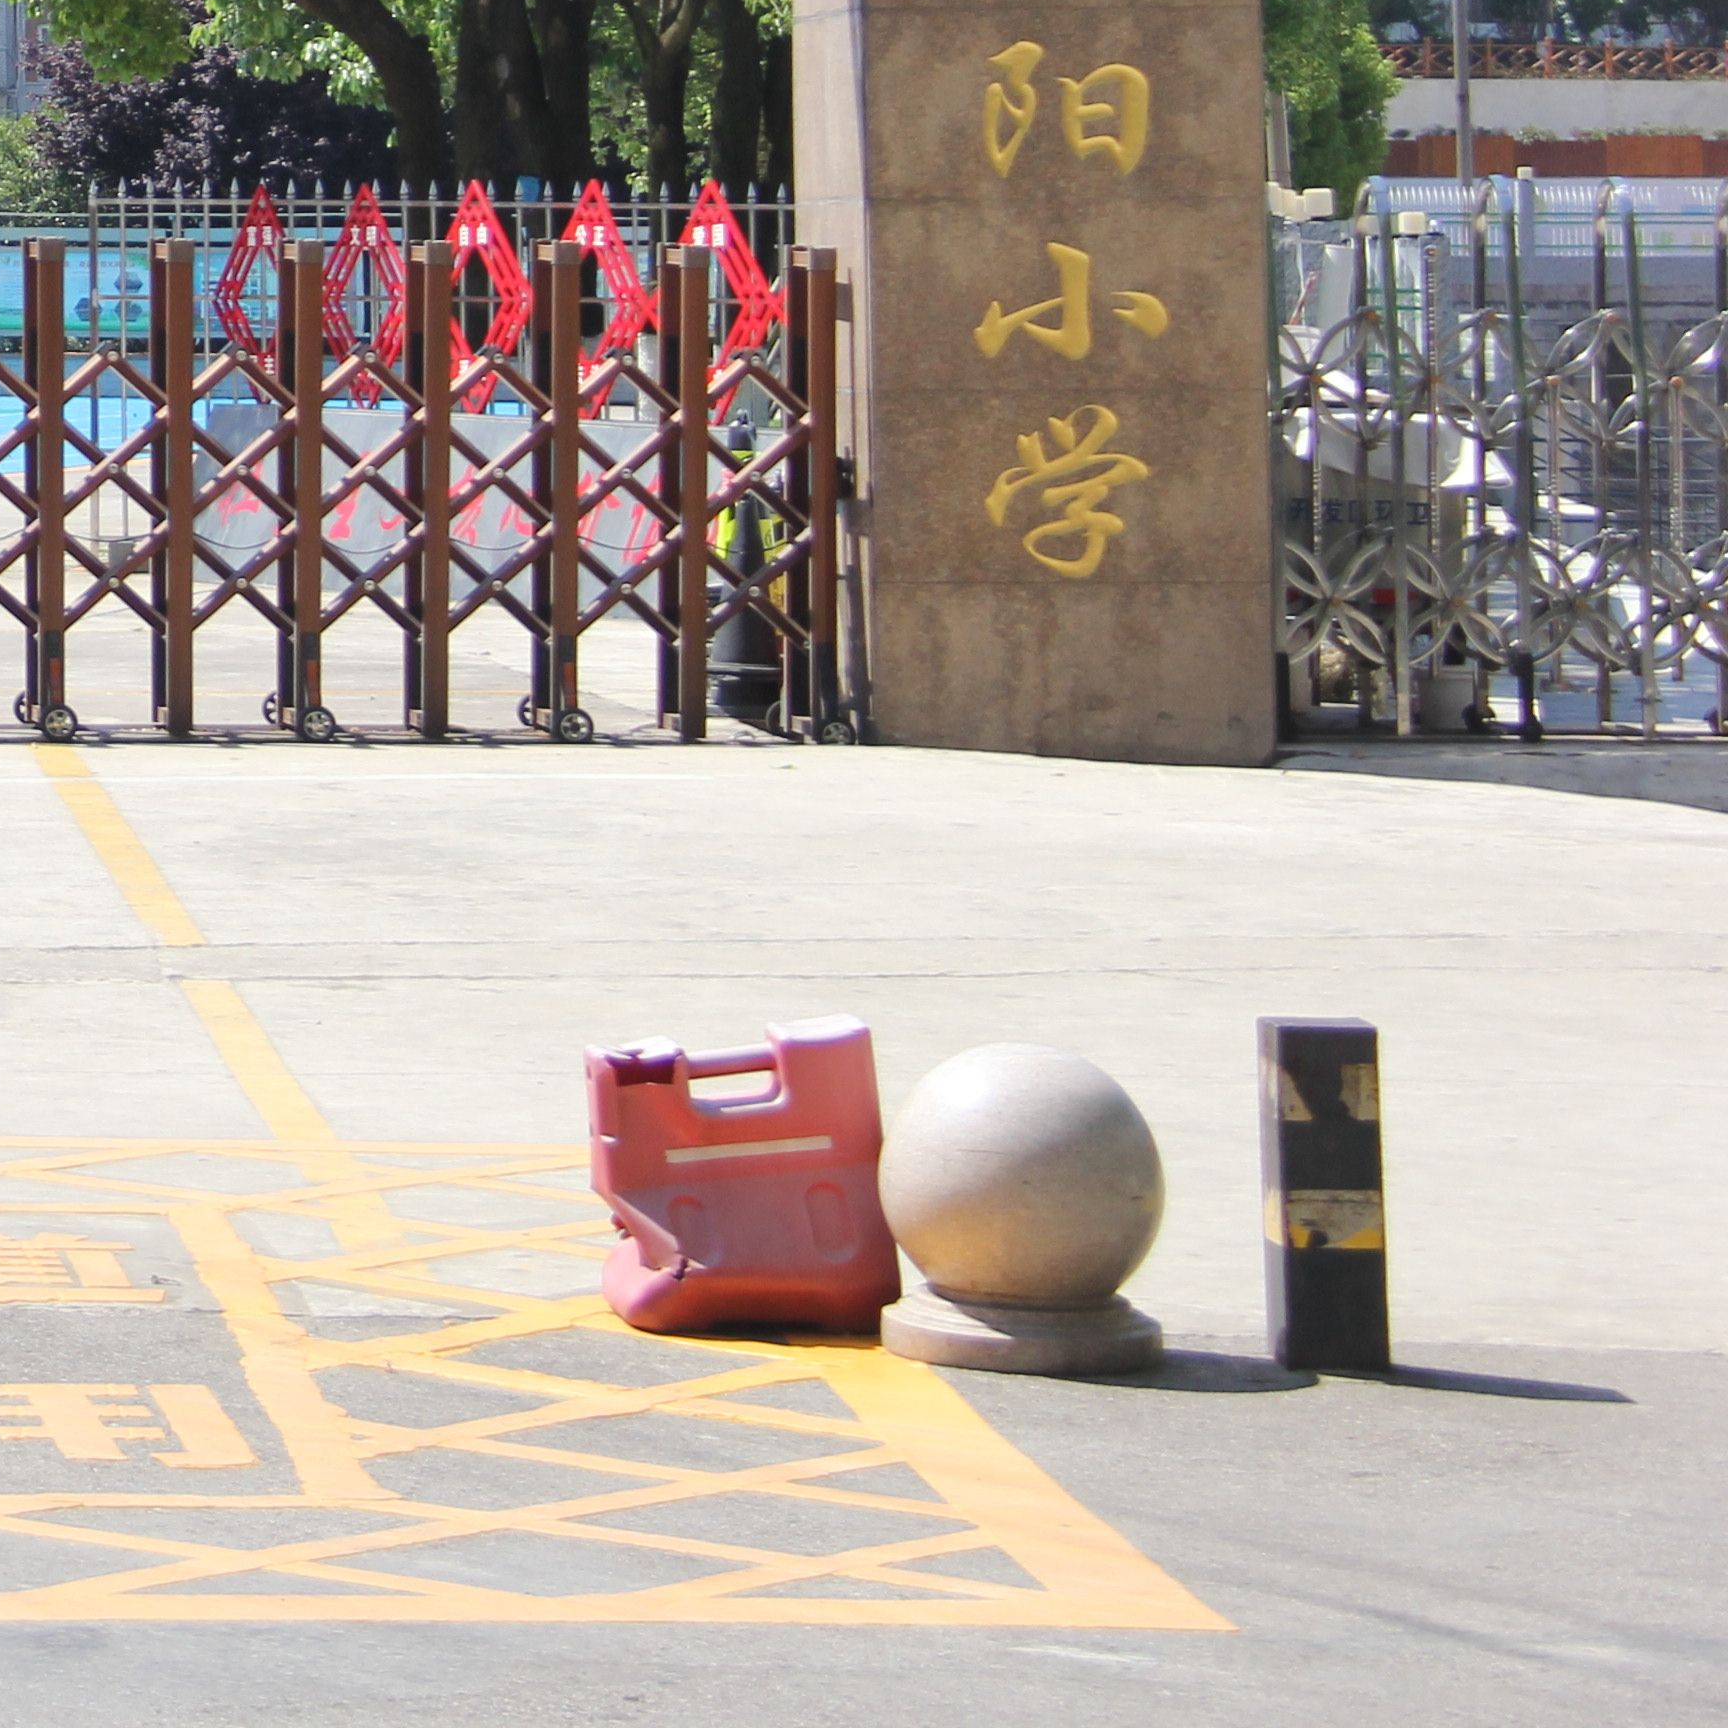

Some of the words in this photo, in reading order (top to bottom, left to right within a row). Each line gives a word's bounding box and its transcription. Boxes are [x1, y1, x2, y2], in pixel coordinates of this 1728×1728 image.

[246, 225, 273, 246] 富强
[350, 225, 377, 246] 文明
[459, 223, 487, 246] 自由
[575, 224, 606, 246] 公正
